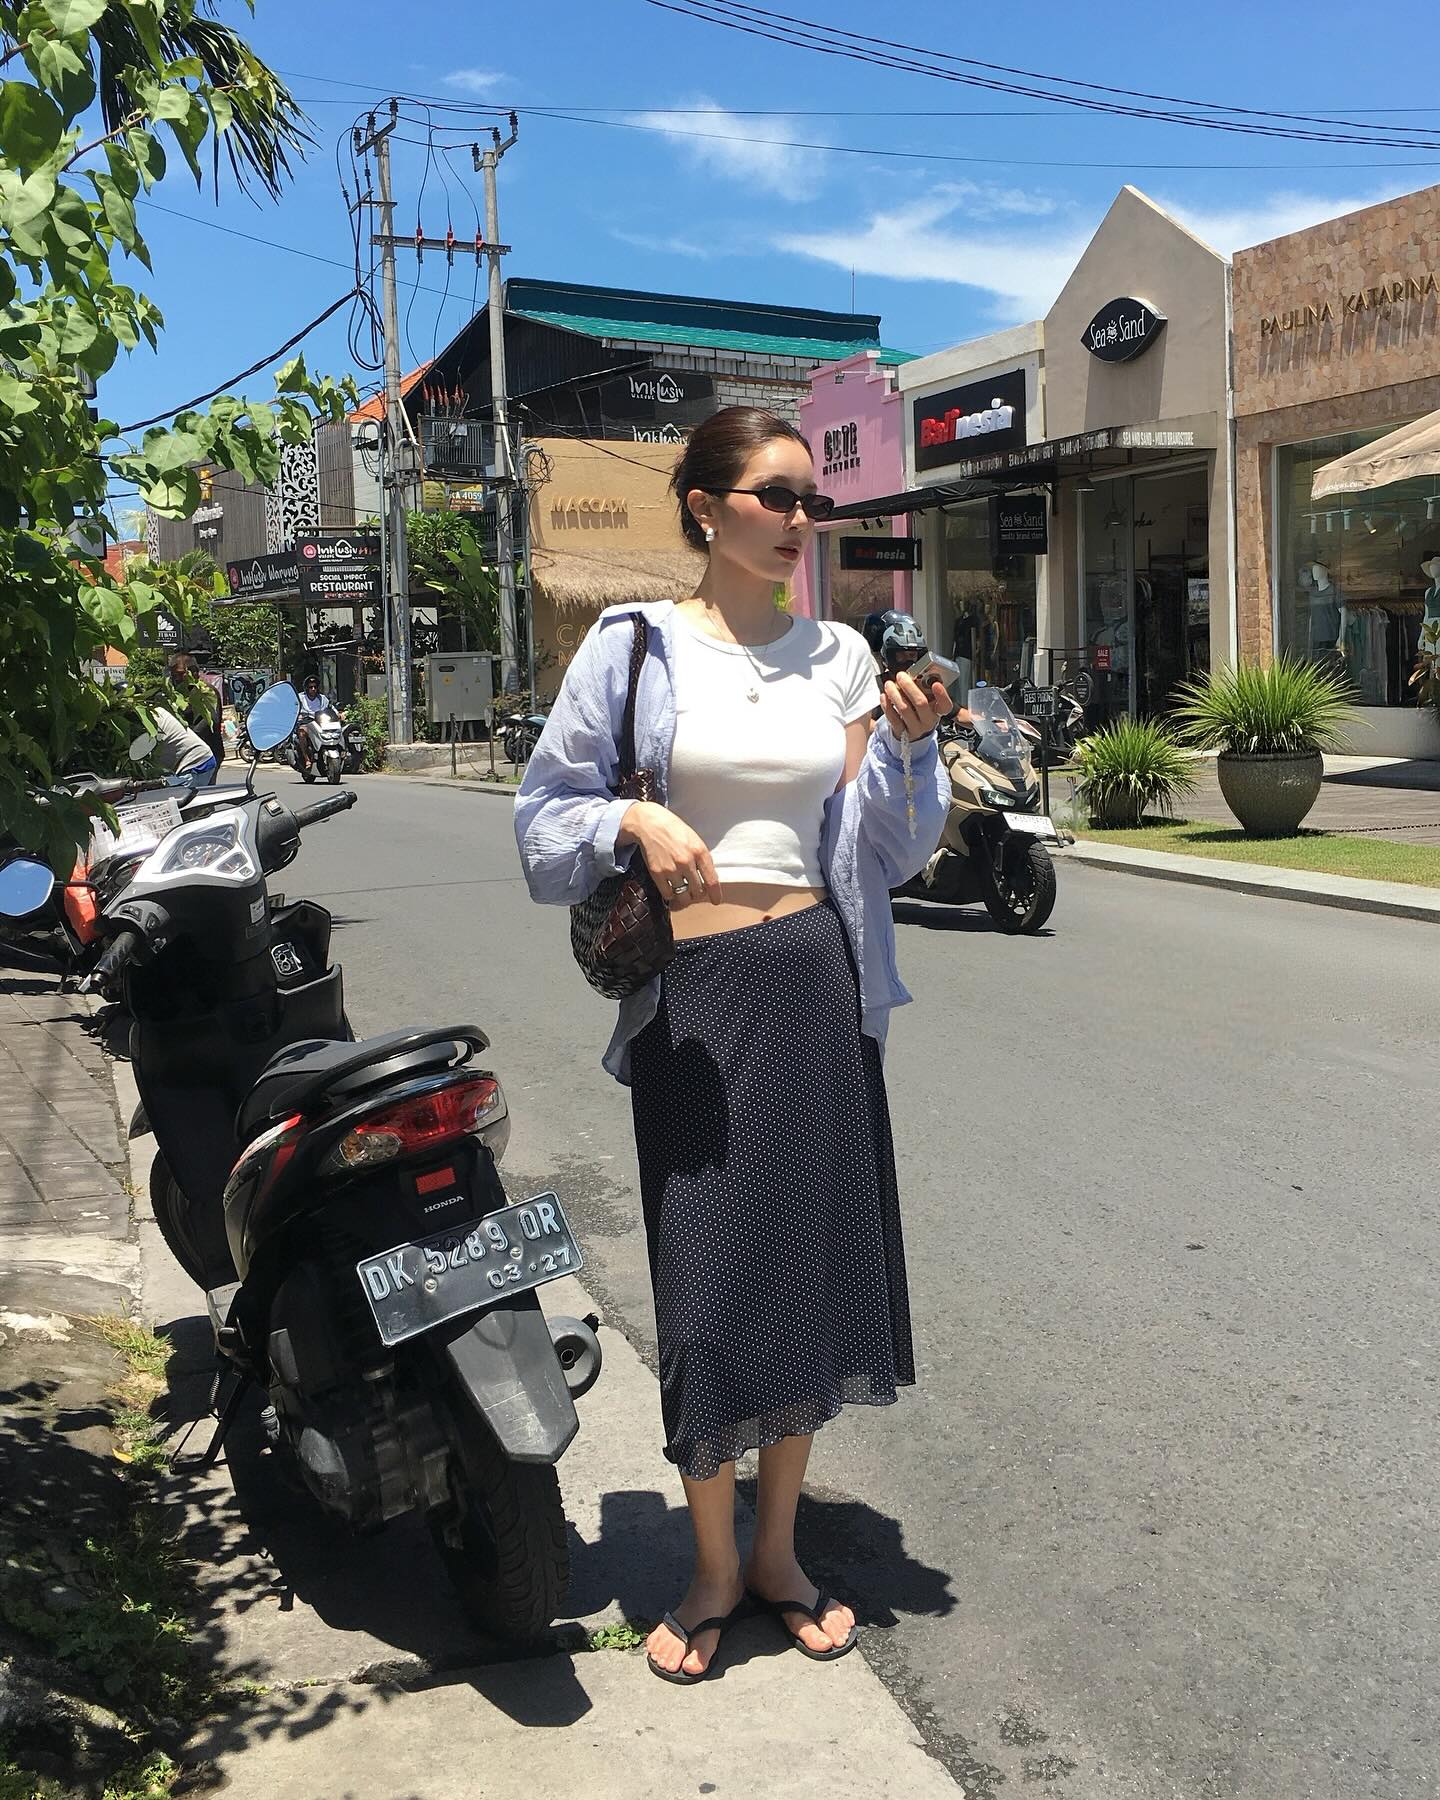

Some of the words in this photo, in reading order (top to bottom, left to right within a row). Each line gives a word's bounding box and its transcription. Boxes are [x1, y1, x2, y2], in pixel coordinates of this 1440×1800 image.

[1261, 301, 1334, 337] PAULINA
[1342, 272, 1440, 315] KATARINA
[1090, 323, 1106, 350] Sea
[1119, 308, 1145, 342] Sand
[628, 373, 684, 403] Inklusiv
[920, 397, 1014, 448] Balinesia
[822, 456, 861, 477] MISTAKE
[462, 491, 482, 500] 4059
[1000, 511, 1013, 527] Sea
[1024, 511, 1043, 527] Sand
[317, 539, 358, 558] Inklusiv
[268, 564, 299, 581] Warung
[343, 573, 367, 581] IMPACT
[310, 581, 375, 593] RESTAURANT
[424, 1195, 465, 1213] HONDA
[365, 1252, 415, 1300] DK
[423, 1221, 508, 1276] 5289
